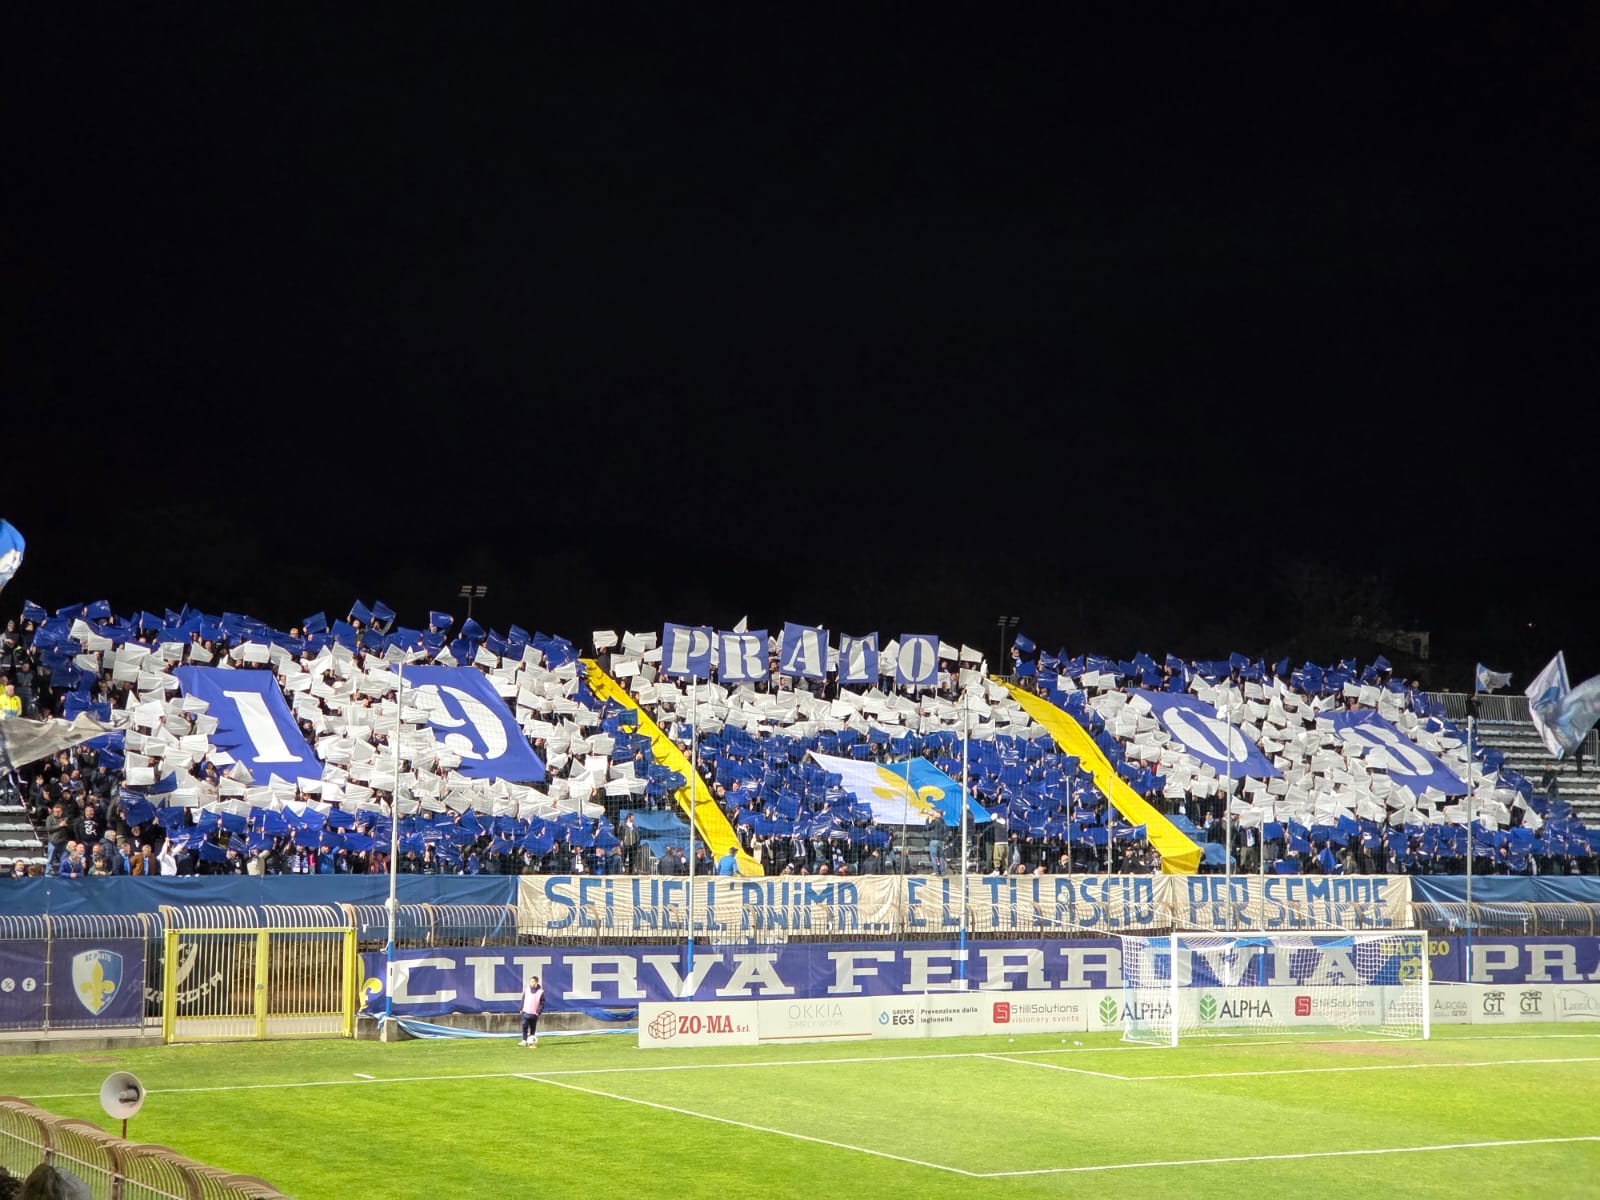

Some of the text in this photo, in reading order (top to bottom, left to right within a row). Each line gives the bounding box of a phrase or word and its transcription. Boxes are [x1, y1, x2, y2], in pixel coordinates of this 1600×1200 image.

[669, 626, 934, 684] PRATO
[907, 878, 927, 927] E
[1187, 876, 1252, 927] PER
[1264, 877, 1393, 928] SEMPRE
[391, 952, 796, 1005] CURVA
[1471, 944, 1600, 983] PR
[788, 1003, 843, 1020] OKKIA
[1120, 1000, 1172, 1021] ALPHA
[1220, 1000, 1273, 1019] ALPHA
[1484, 997, 1504, 1012] GT
[1520, 997, 1542, 1012] GT
[678, 1014, 734, 1034] ZO-MA
[892, 1015, 915, 1025] EGS
